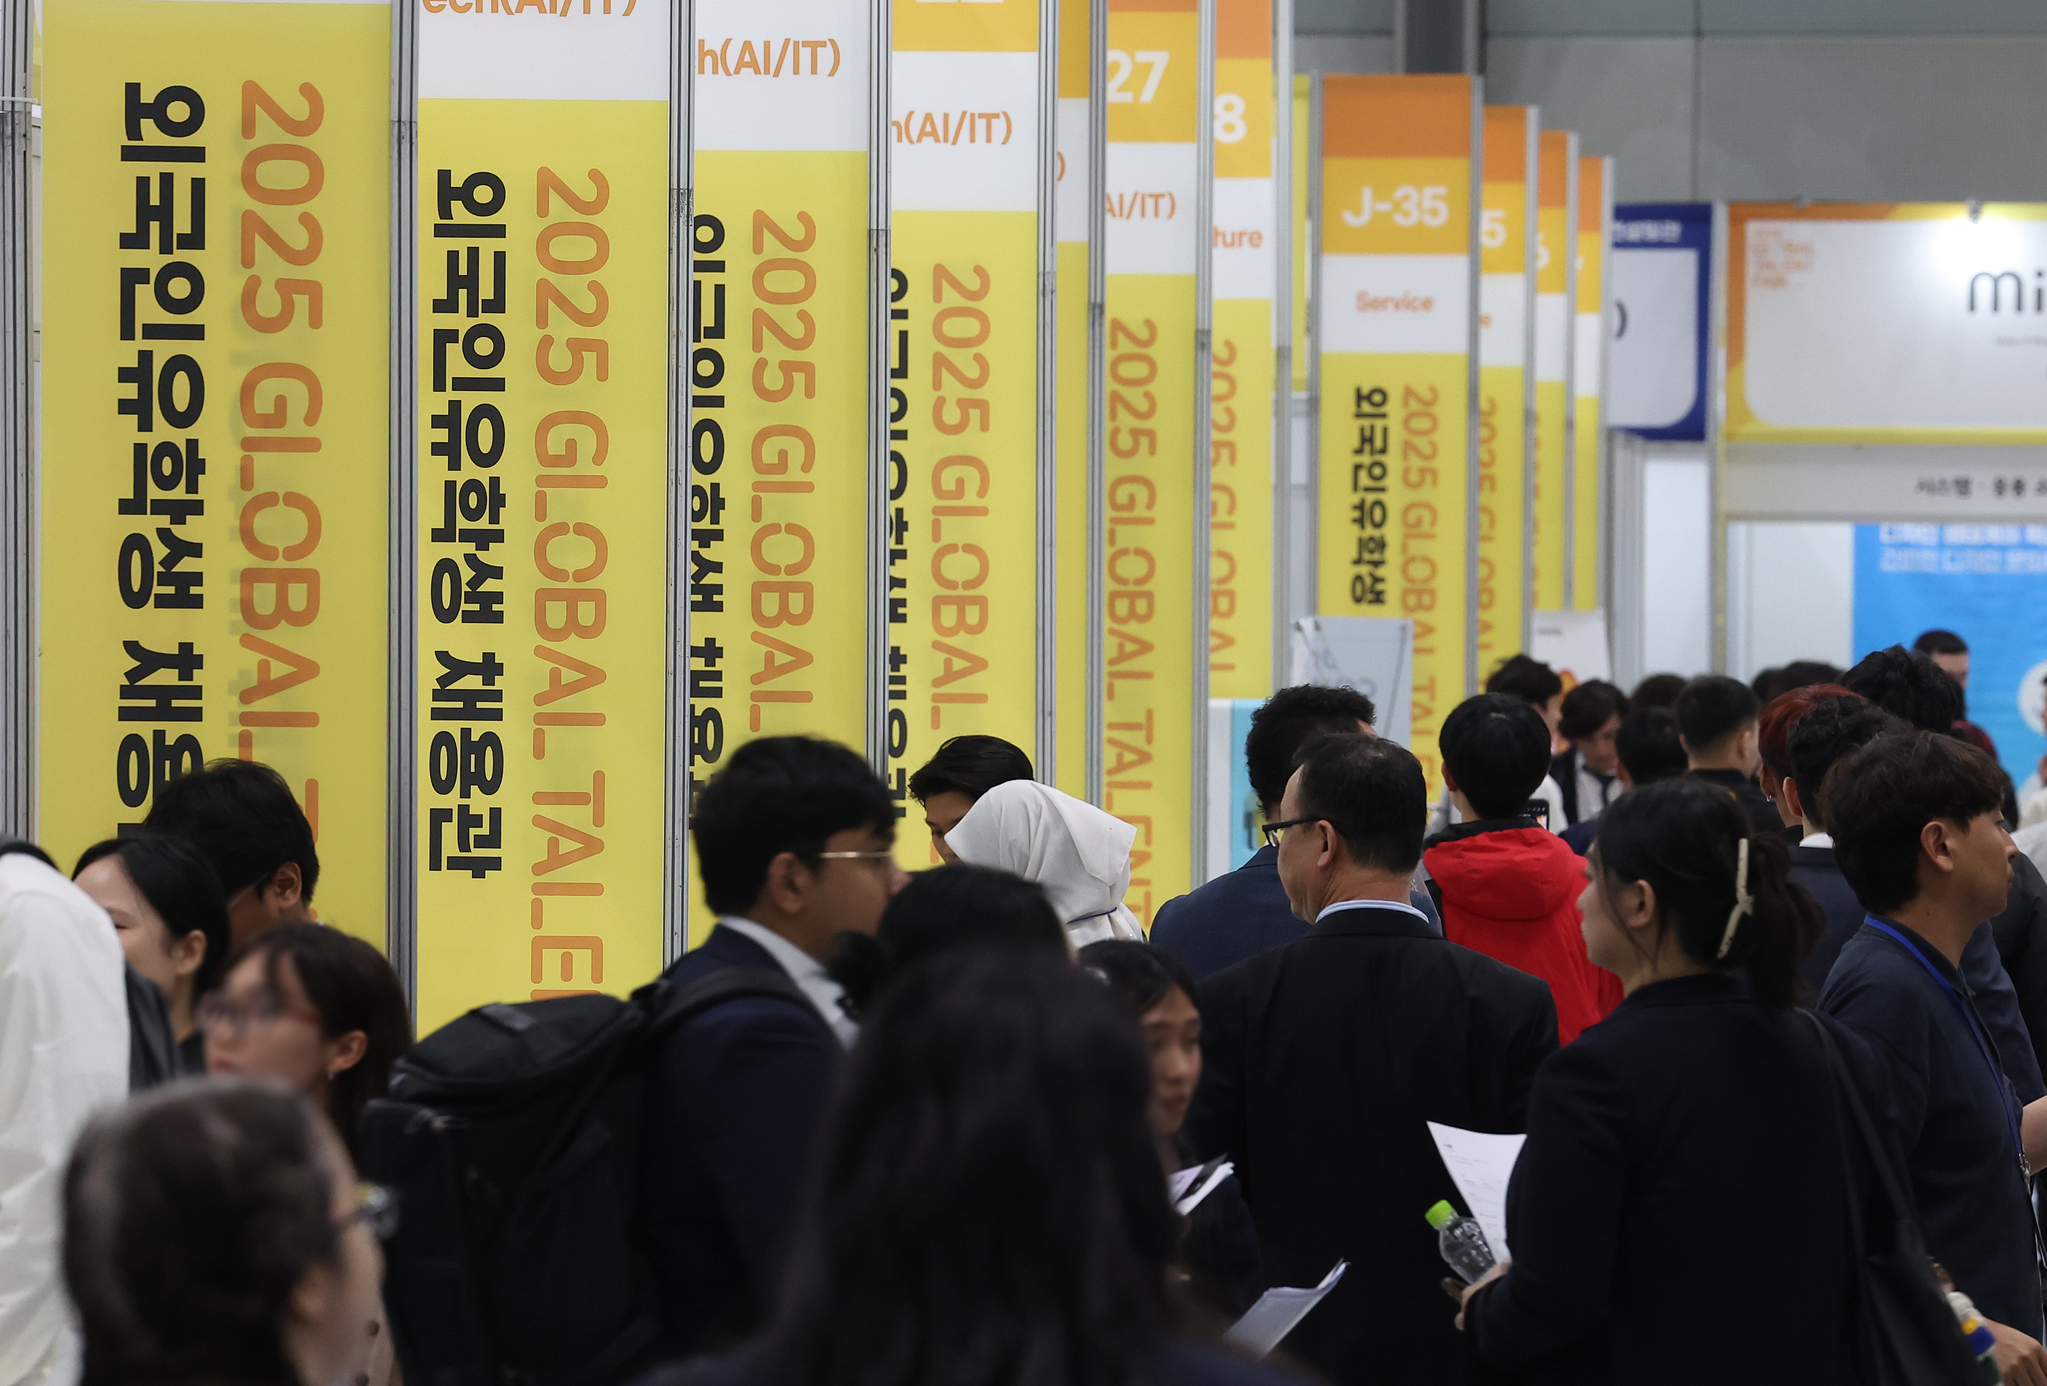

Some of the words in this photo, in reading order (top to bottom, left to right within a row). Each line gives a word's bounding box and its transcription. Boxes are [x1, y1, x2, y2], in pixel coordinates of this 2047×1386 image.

[240, 79, 325, 334] 2025
[535, 166, 610, 386] 2025
[752, 208, 817, 403] 2025
[1342, 186, 1449, 228] J-35
[1355, 291, 1435, 314] Service
[117, 81, 206, 610] 외국인유학생
[430, 168, 506, 625] 외국인유학생
[932, 263, 991, 436] 2025
[1109, 317, 1158, 460] 2025
[1402, 383, 1440, 490] 2025
[238, 360, 323, 762] GLOBAL
[532, 409, 609, 761] GLOBAL
[750, 423, 816, 733] GLOBAL
[930, 454, 990, 730] GLOBAL
[1107, 474, 1157, 700] GLOBAL
[1351, 386, 1389, 606] 외국인유학생
[116, 639, 204, 838] 채용
[428, 650, 504, 879] 채용관
[529, 769, 606, 1000] TALE
